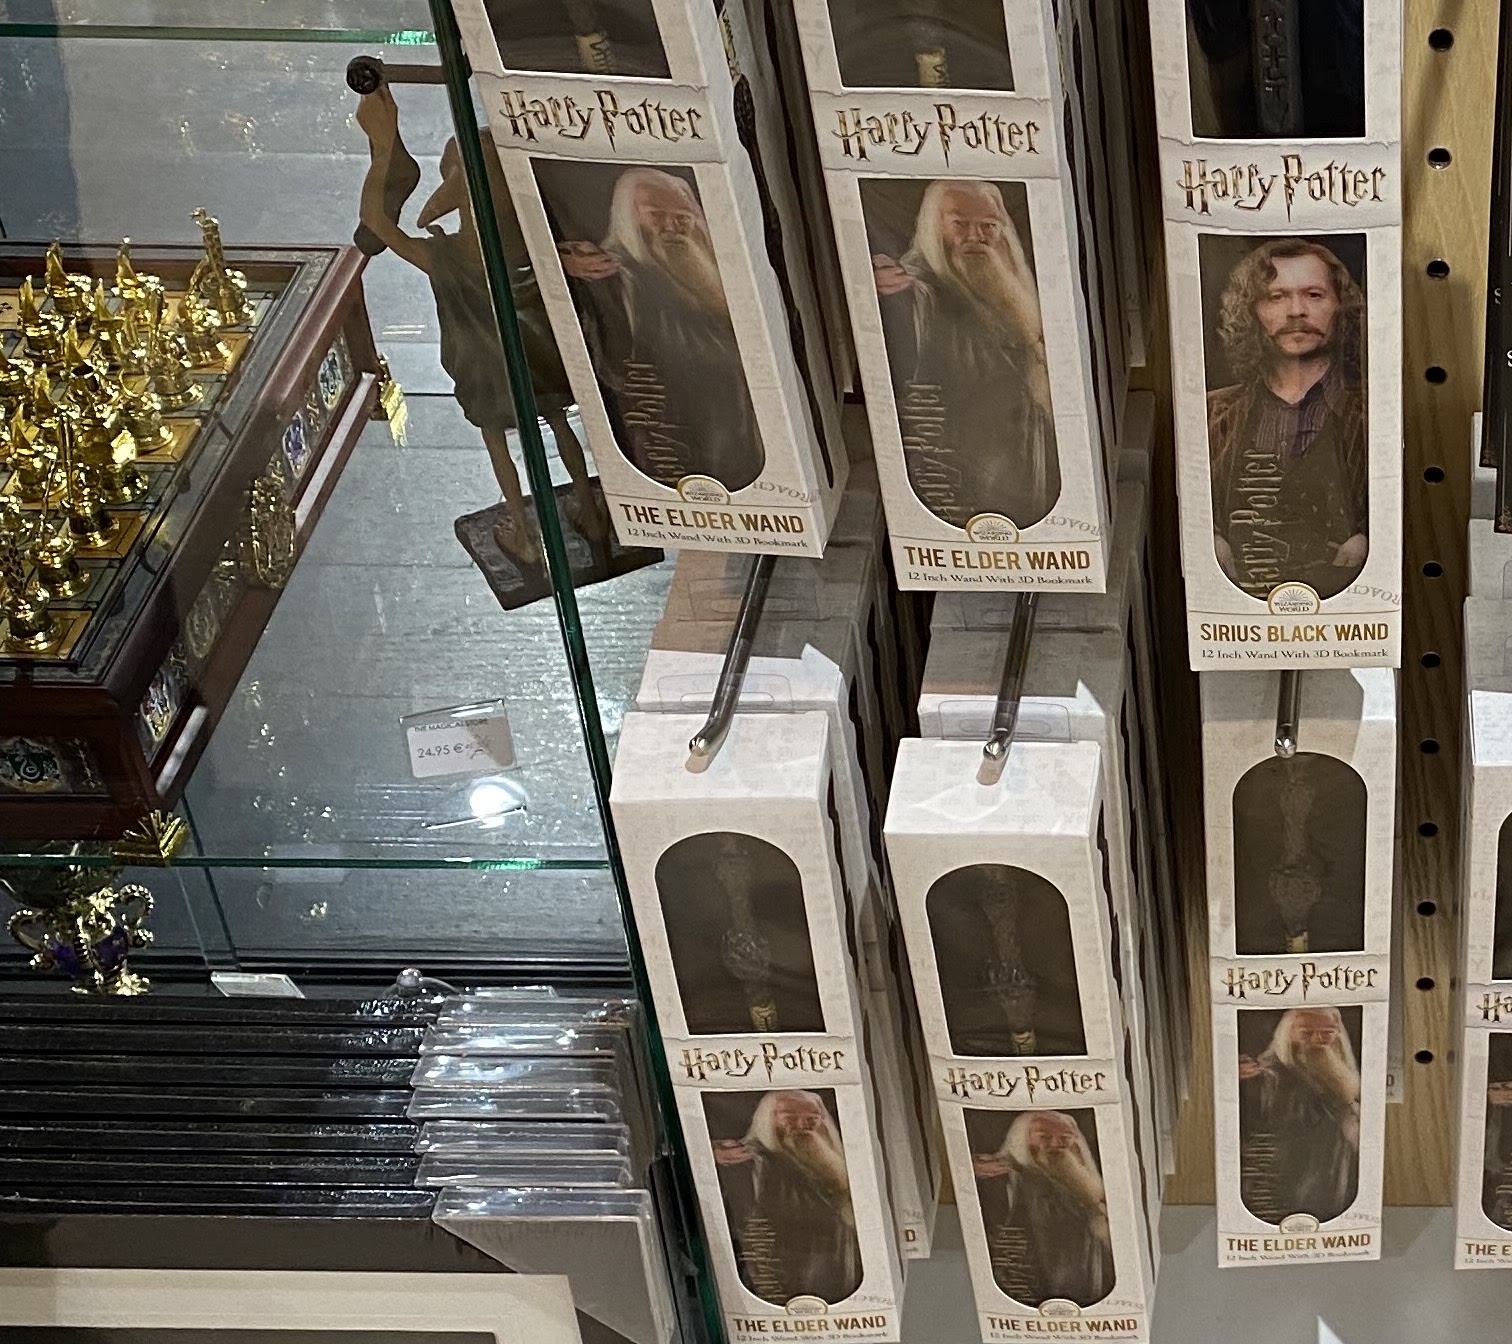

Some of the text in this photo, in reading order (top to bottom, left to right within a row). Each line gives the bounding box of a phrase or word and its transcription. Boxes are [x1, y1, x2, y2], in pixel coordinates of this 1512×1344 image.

[499, 89, 704, 154] Harry Potter
[831, 103, 1040, 169] Harry Potter
[1175, 153, 1388, 223] Harry Potter
[618, 503, 805, 534] THE ELDER WAND
[626, 527, 809, 550] 12 Inch Wand With 3D Bookmark
[903, 545, 1091, 571] THE ELDER WAND
[907, 570, 1093, 585] 12 Inch Wand With 3D Bookmark
[1200, 621, 1390, 643] SIRIUS BLACK WAND
[1201, 647, 1390, 660] 12 Inch Wand With 3D Bookmark
[416, 742, 465, 759] 24.95 €
[1221, 962, 1379, 1001] Harry Potter
[678, 1042, 846, 1083] Harry Potter
[943, 1065, 1107, 1104] Harry Potter
[1226, 1233, 1372, 1252] THE ELDER WAND
[1464, 1242, 1498, 1256] THE
[732, 1314, 888, 1334] THE ELDER WAND
[987, 1316, 1139, 1333] THE ELDER WAND
